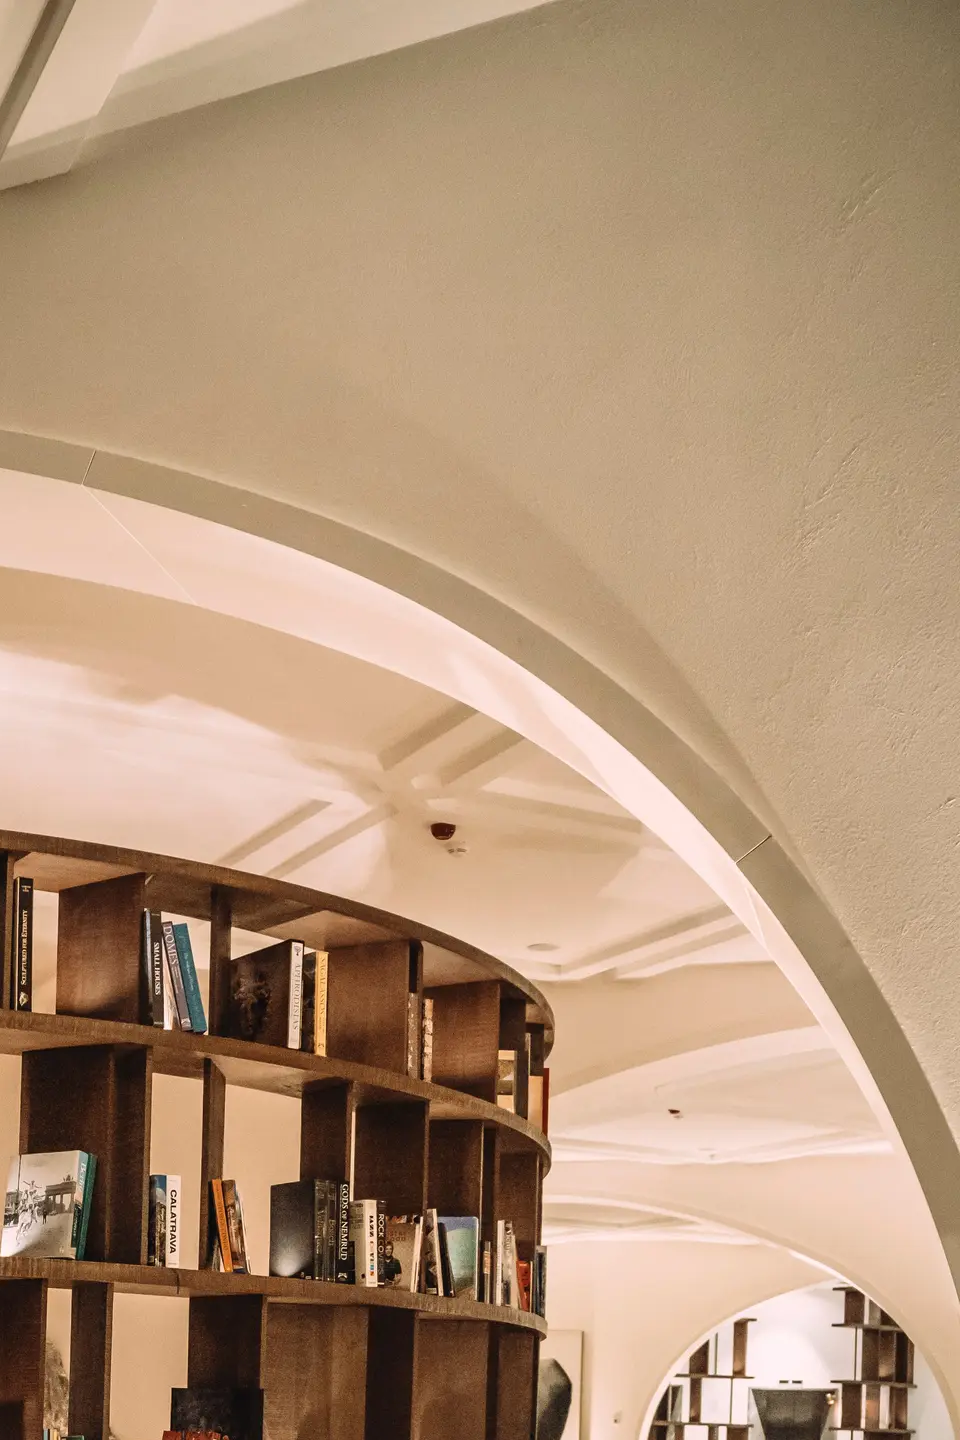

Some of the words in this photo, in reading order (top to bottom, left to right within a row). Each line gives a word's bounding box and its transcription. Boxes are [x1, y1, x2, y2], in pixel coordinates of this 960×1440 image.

[163, 925, 179, 965] DOMES
[341, 1183, 349, 1210] GODS
[169, 1189, 178, 1254] CALATRAVA
[340, 1221, 349, 1261] NEMRUD
